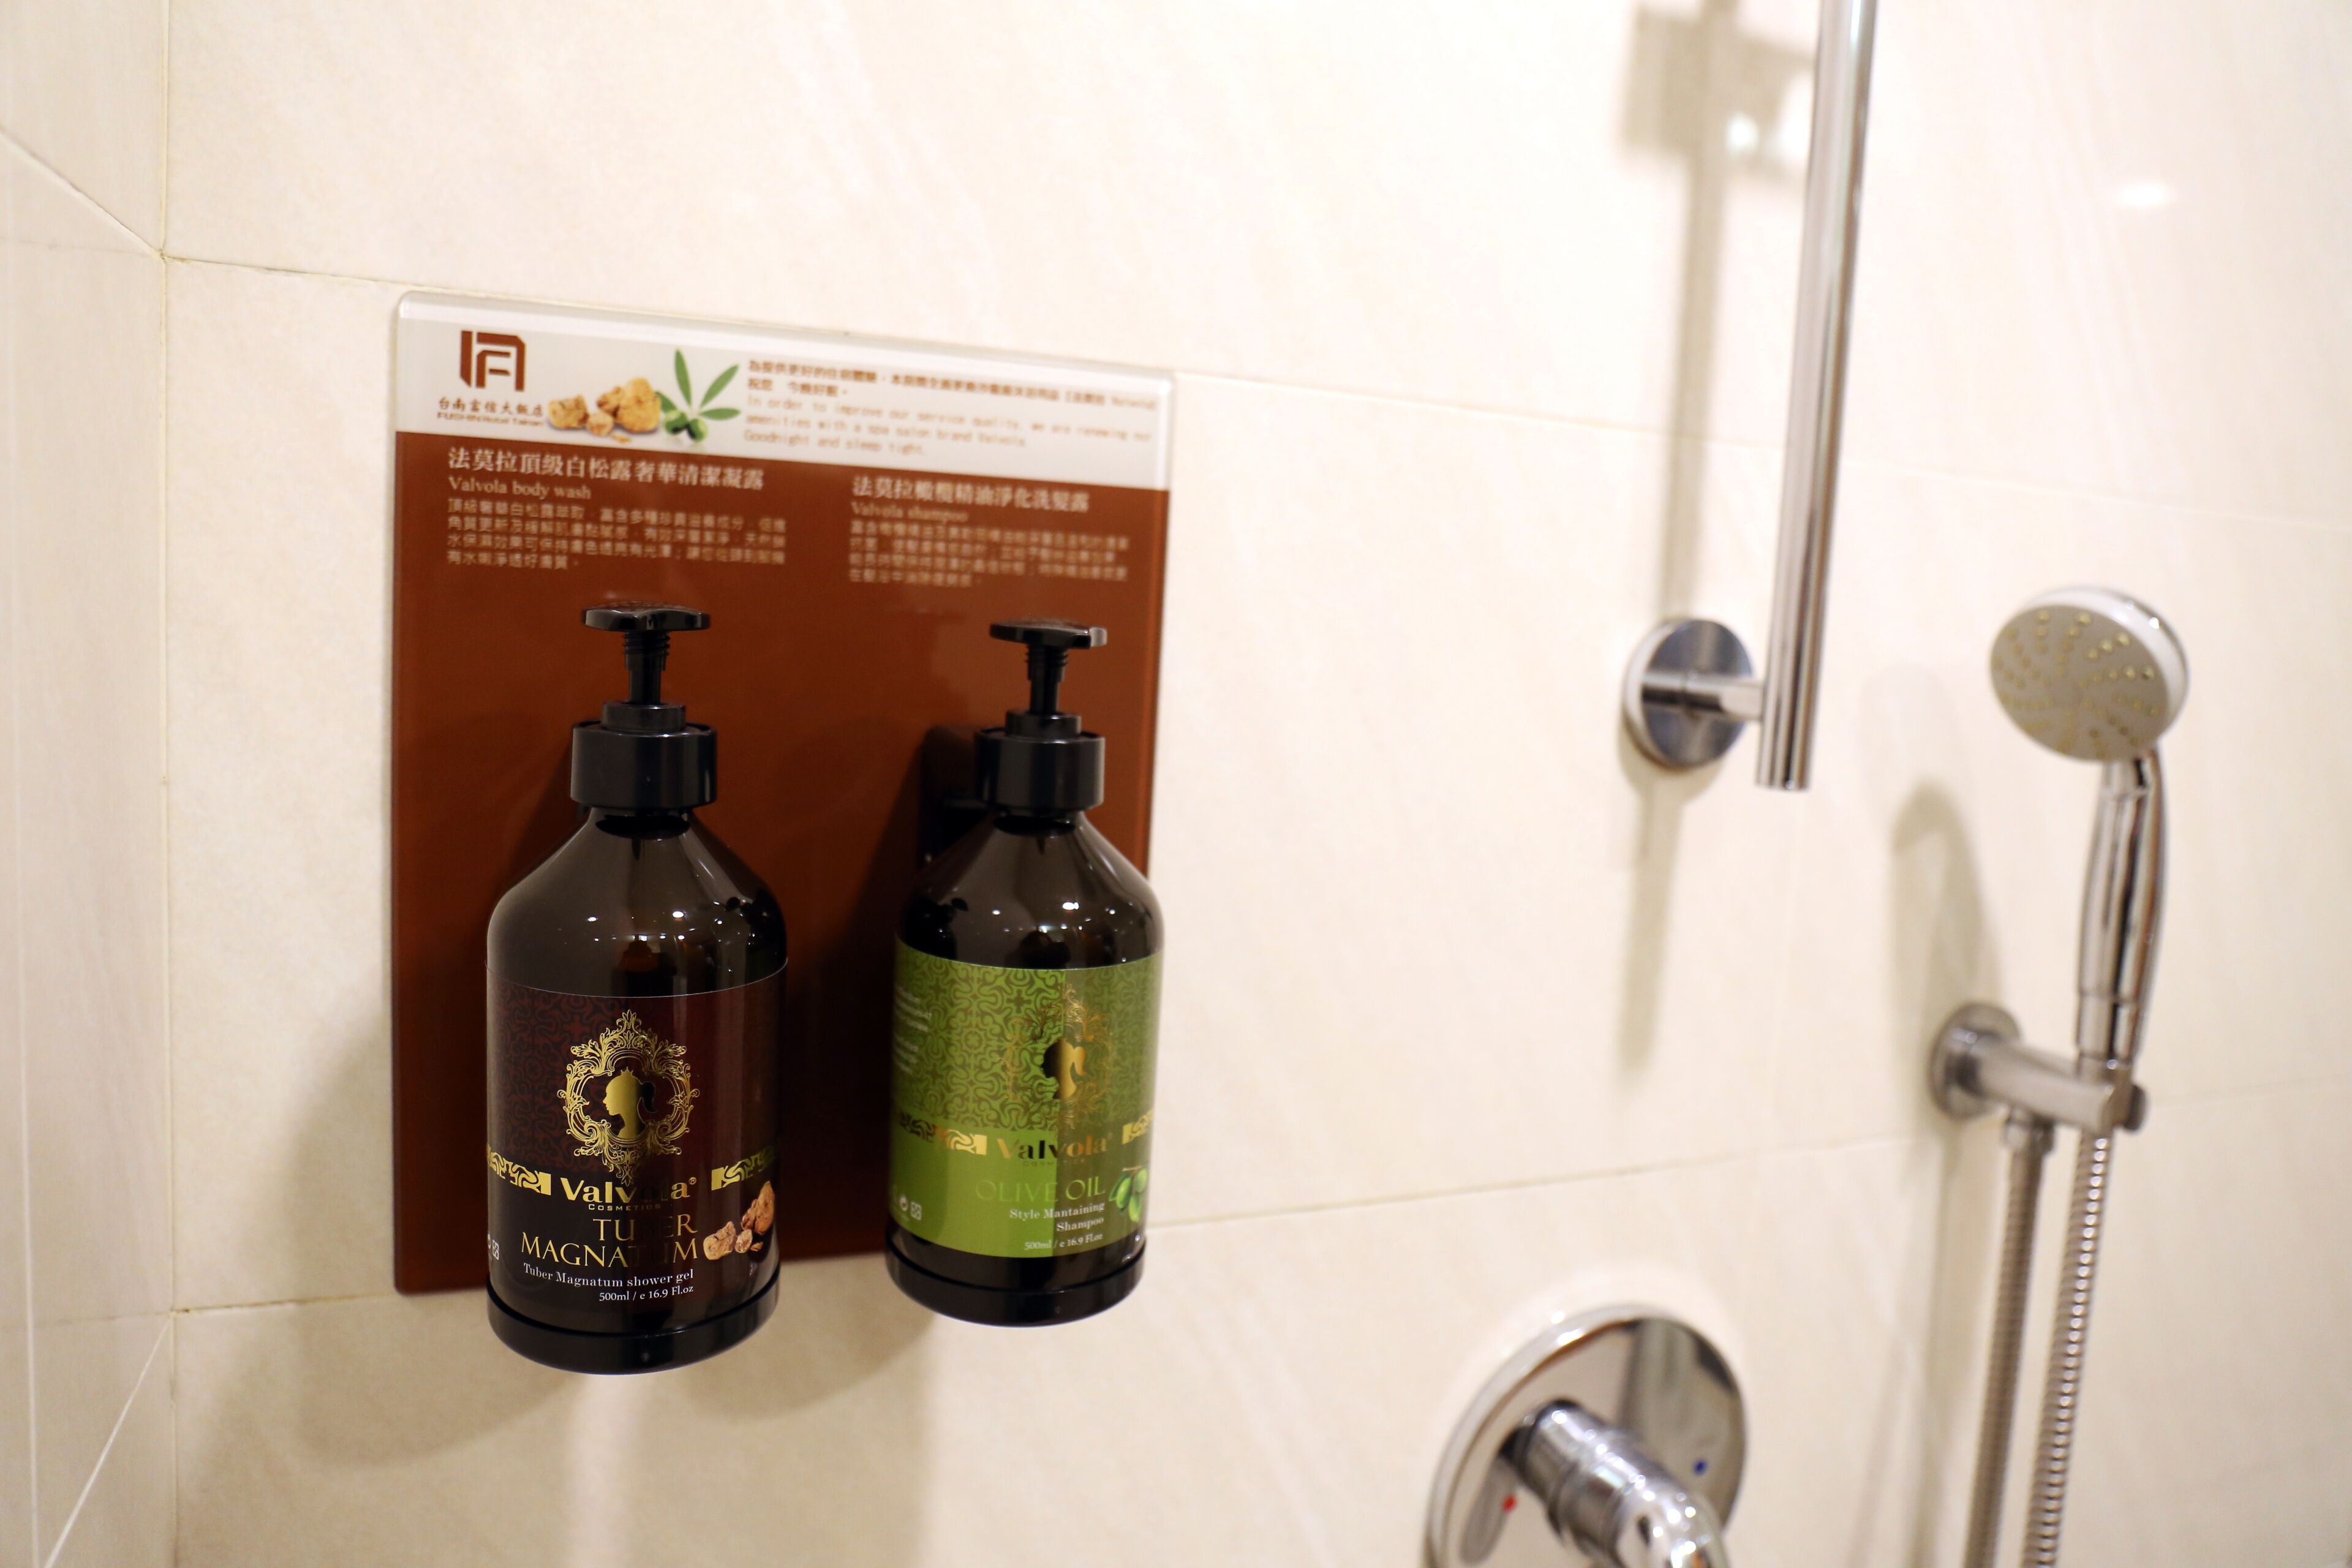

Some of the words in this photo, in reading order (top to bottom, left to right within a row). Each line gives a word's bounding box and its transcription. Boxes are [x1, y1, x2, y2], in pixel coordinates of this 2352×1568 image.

[448, 477, 508, 494] Valvola
[513, 481, 549, 500] body
[554, 485, 591, 499] wash
[975, 1179, 1058, 1202] OLIVE
[1066, 1175, 1106, 1200] OIL
[1009, 1208, 1040, 1221] Style
[1044, 1202, 1105, 1219] Mantaining
[593, 1213, 698, 1241] TUER
[1057, 1217, 1104, 1232] Shampoo
[521, 1232, 698, 1268] MAGNATM
[1024, 1240, 1052, 1250] 500ml
[1068, 1236, 1084, 1246] 16.9
[524, 1263, 553, 1280] Tuber
[556, 1272, 623, 1287] Magnatum
[627, 1274, 673, 1287] shower
[676, 1268, 693, 1284] gel
[599, 1291, 630, 1302] 500ml
[649, 1289, 668, 1299] 16.9
[672, 1285, 694, 1296] Fl.oz
